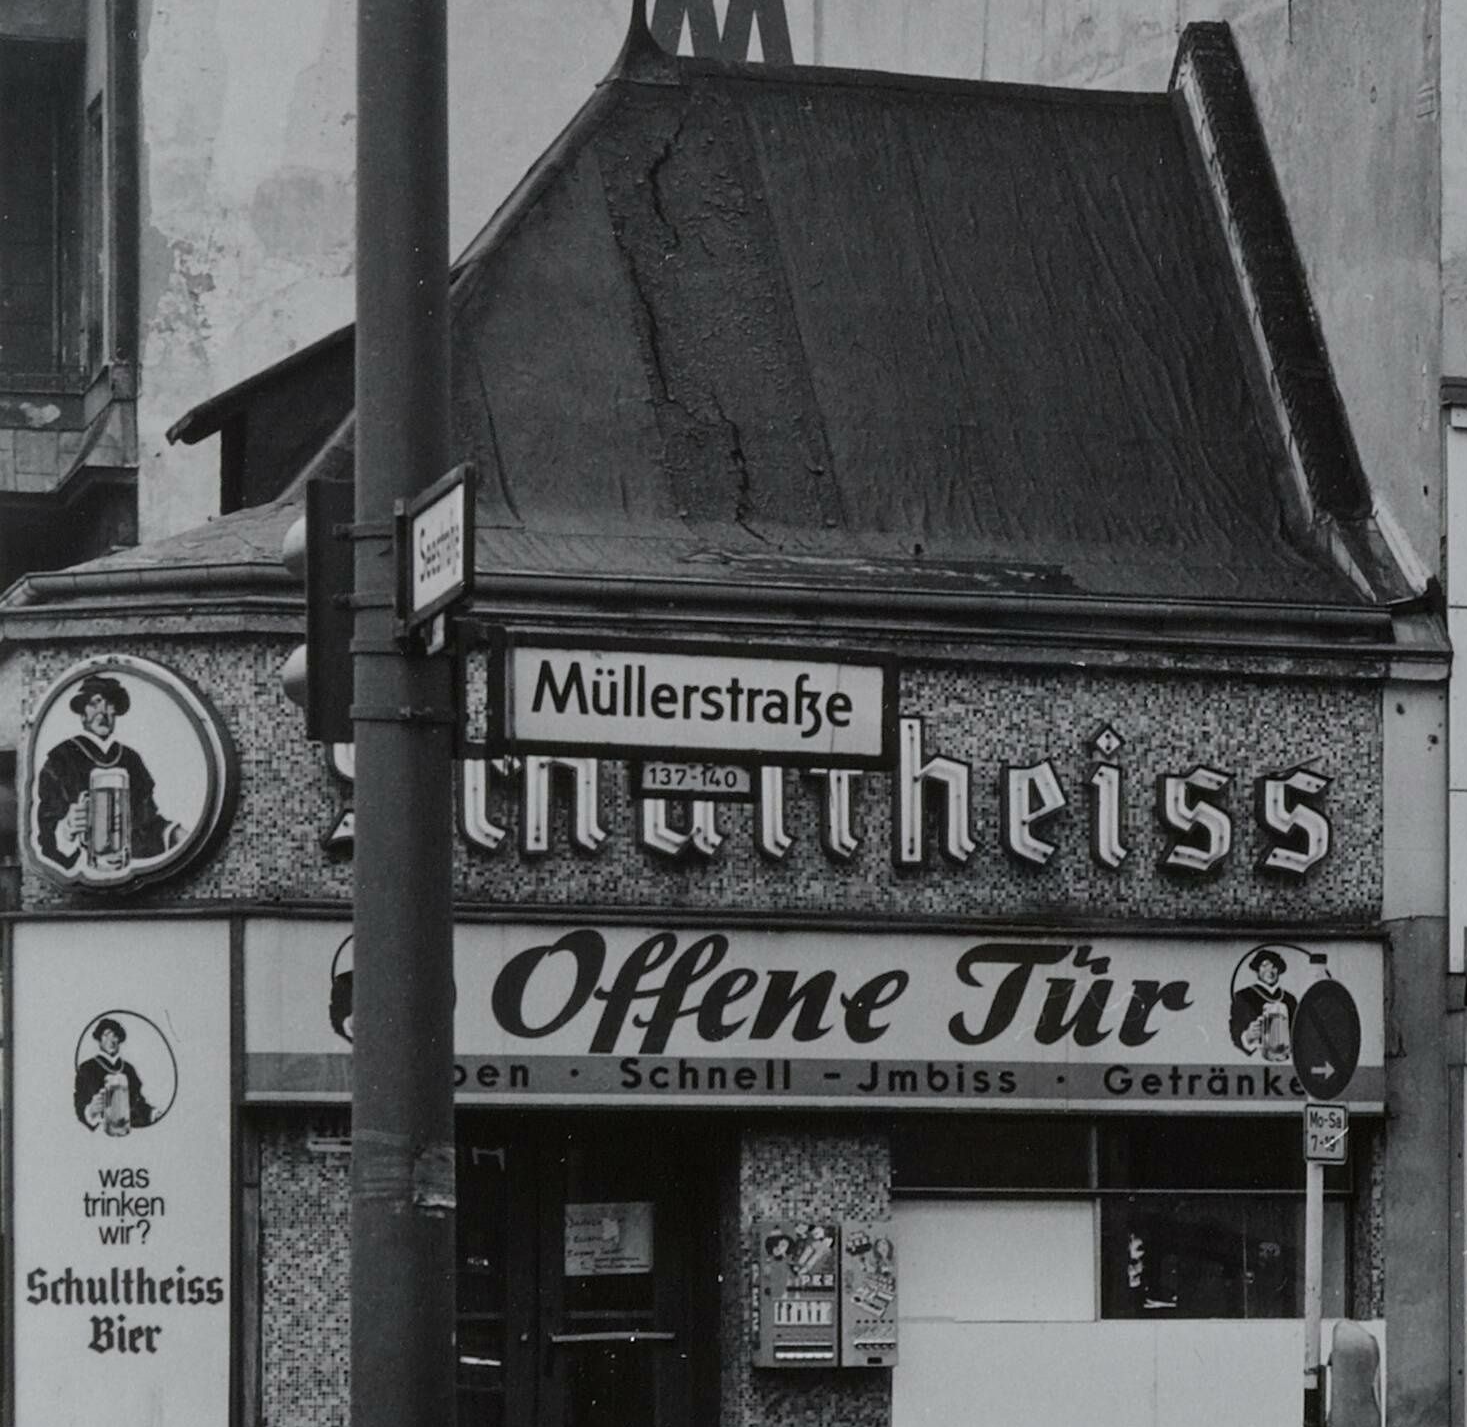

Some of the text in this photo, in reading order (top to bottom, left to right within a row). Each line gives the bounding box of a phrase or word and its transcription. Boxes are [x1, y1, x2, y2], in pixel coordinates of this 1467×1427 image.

[531, 659, 854, 739] Müllerstraße
[322, 715, 1336, 875] chultheiss
[647, 767, 738, 789] 137-140
[490, 928, 1194, 1056] Offene Tür
[619, 1056, 792, 1091] Schnell
[1102, 1063, 1304, 1097] Getränke
[1309, 1111, 1342, 1129] Mo-Sa
[98, 1168, 150, 1190] was
[83, 1191, 165, 1218] trinken
[98, 1219, 152, 1245] wir?
[26, 1265, 224, 1306] Schultheiss
[88, 1316, 161, 1355] Bier
